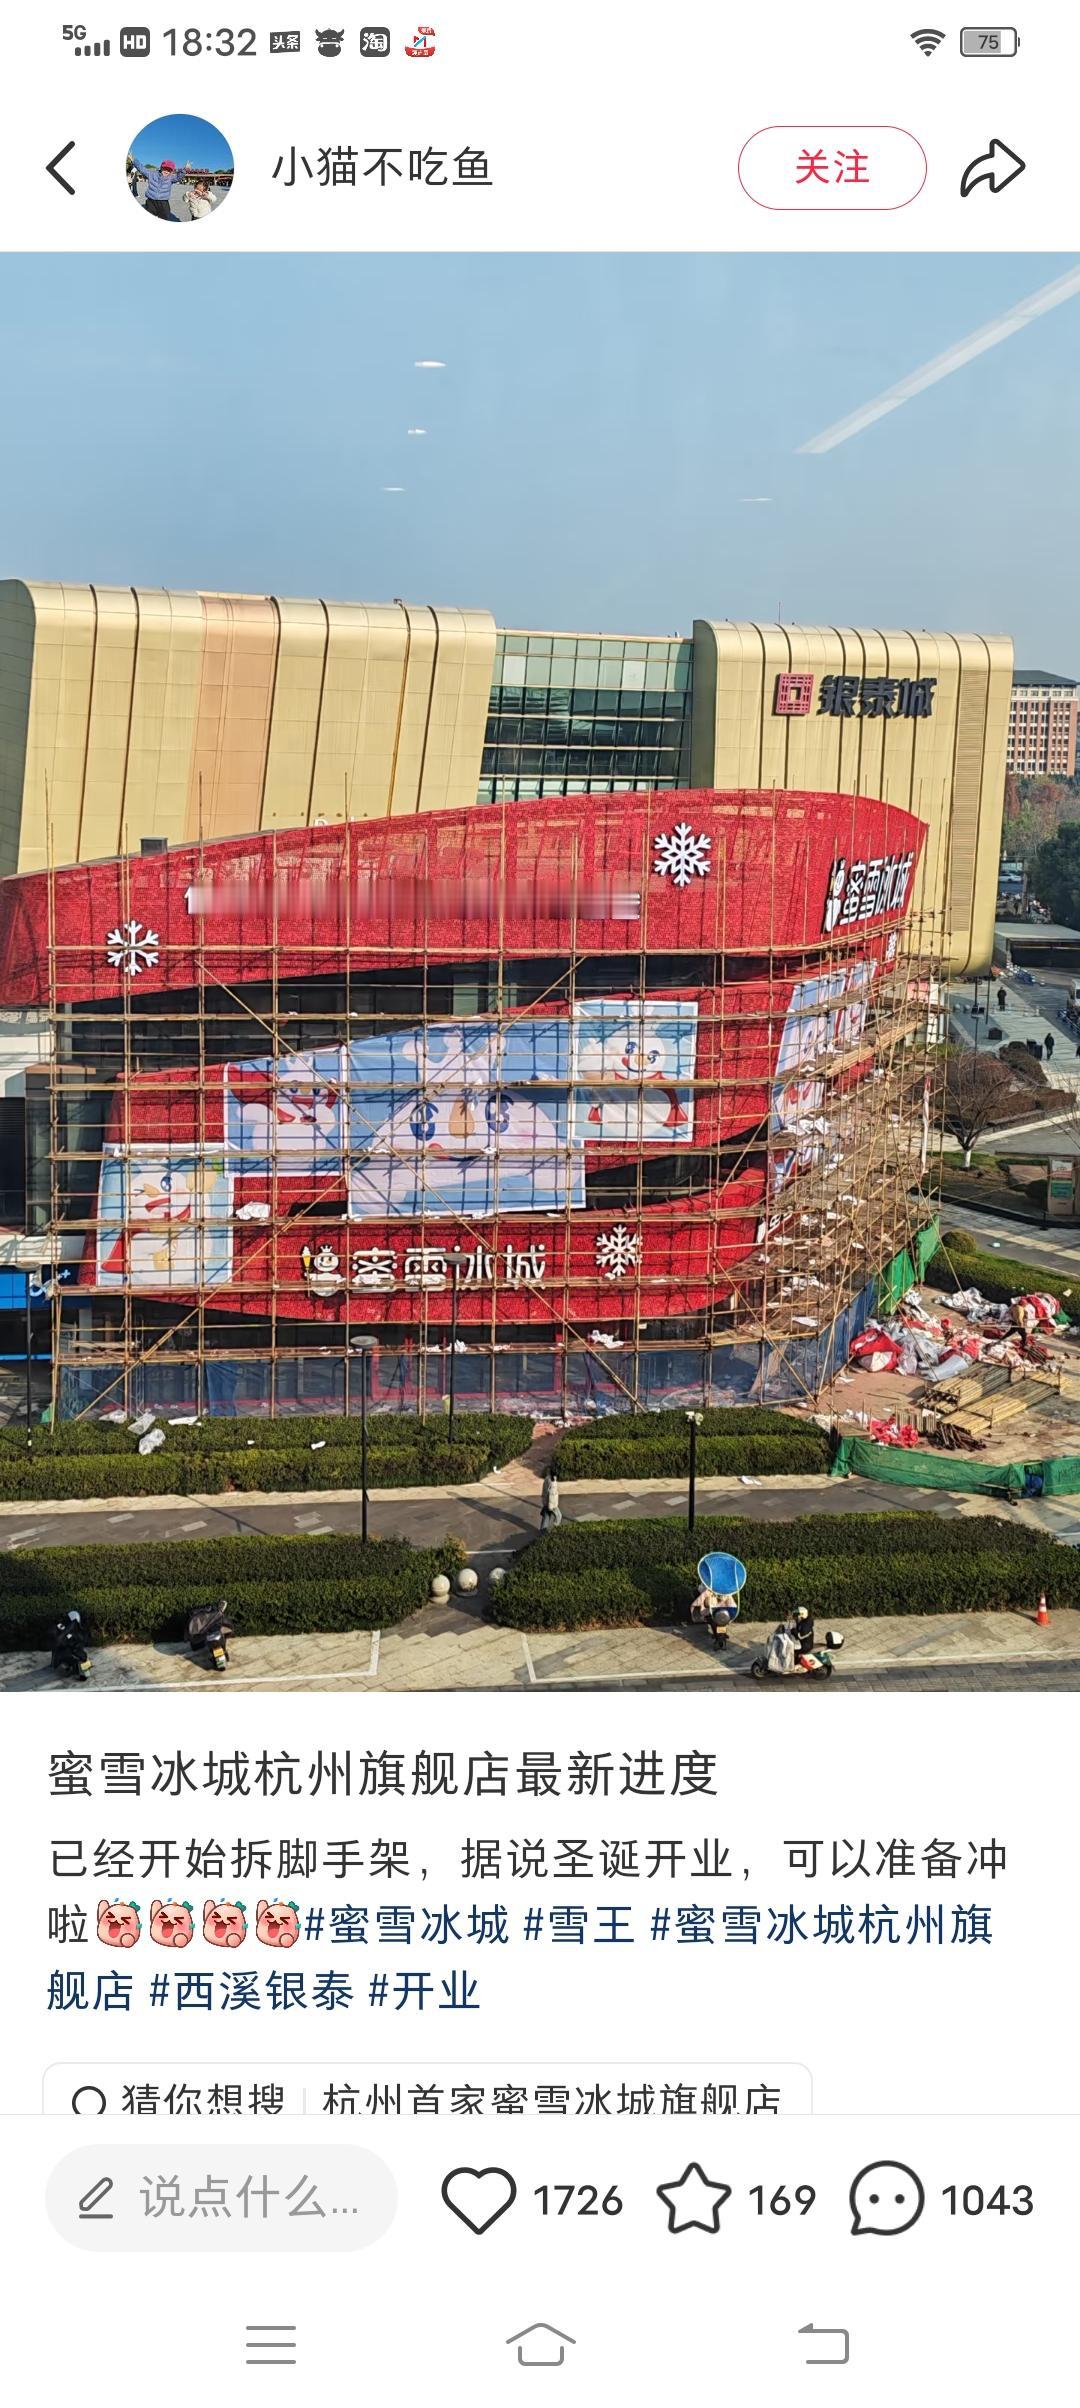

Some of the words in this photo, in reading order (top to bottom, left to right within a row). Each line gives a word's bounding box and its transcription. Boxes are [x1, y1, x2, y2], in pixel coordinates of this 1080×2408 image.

[62, 24, 87, 41] 5G
[122, 34, 147, 50] HD
[163, 27, 257, 57] 18:32
[271, 34, 300, 51] 头条
[361, 32, 389, 52] 淘
[978, 34, 1000, 50] 75
[271, 145, 494, 187] 小猫不吃鱼
[795, 148, 870, 185] 关注
[817, 674, 937, 718] 银泰城
[839, 851, 914, 926] 蜜雪冰城
[351, 1245, 546, 1294] 蜜雪冰城
[47, 1749, 718, 1797] 蜜雪冰城杭州旗舰店最新进度
[48, 1903, 89, 1944] 啦
[304, 1903, 510, 1945] #蜜雪冰城
[523, 1903, 635, 1945] #雪王
[650, 1903, 993, 1945] #蜜雪冰城杭州旗
[46, 1968, 133, 2012] 舰店
[149, 1968, 355, 2012] #西溪银泰
[368, 1968, 481, 2012] #开业
[121, 2082, 284, 2114] 猜你想搜
[322, 2082, 781, 2114] 杭州首家蜜雪冰城旗舰店
[139, 2174, 358, 2218] 说点什么...
[533, 2184, 624, 2216] 1726
[748, 2184, 817, 2216] 169
[941, 2184, 1034, 2216] 1043
